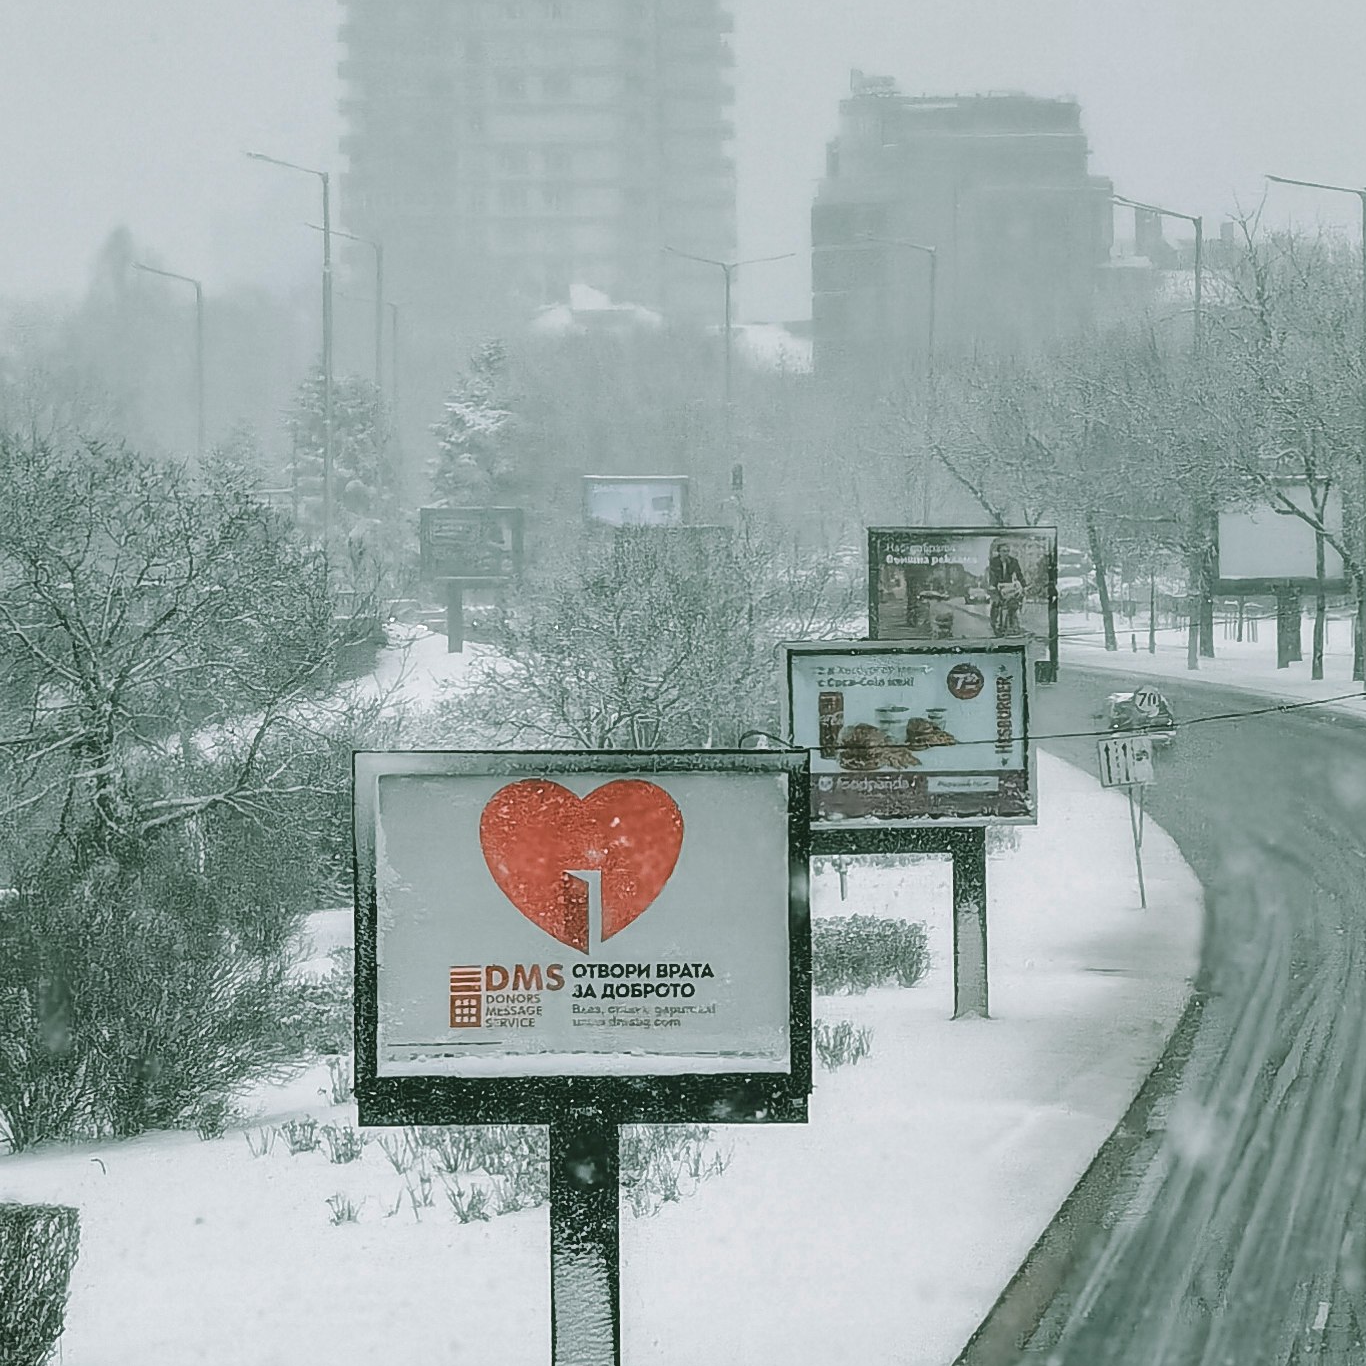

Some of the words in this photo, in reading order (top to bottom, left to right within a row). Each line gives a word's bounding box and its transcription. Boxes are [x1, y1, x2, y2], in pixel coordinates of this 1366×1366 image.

[1138, 692, 1157, 707] 70
[485, 964, 565, 991] DMS
[572, 963, 651, 978] ОТВОРИ
[656, 963, 714, 978] ВРАТА
[572, 983, 597, 998] ЗА
[600, 983, 695, 999] ДОБРОТО
[486, 994, 541, 1004] DONORS
[486, 1005, 543, 1016] MESSAGE
